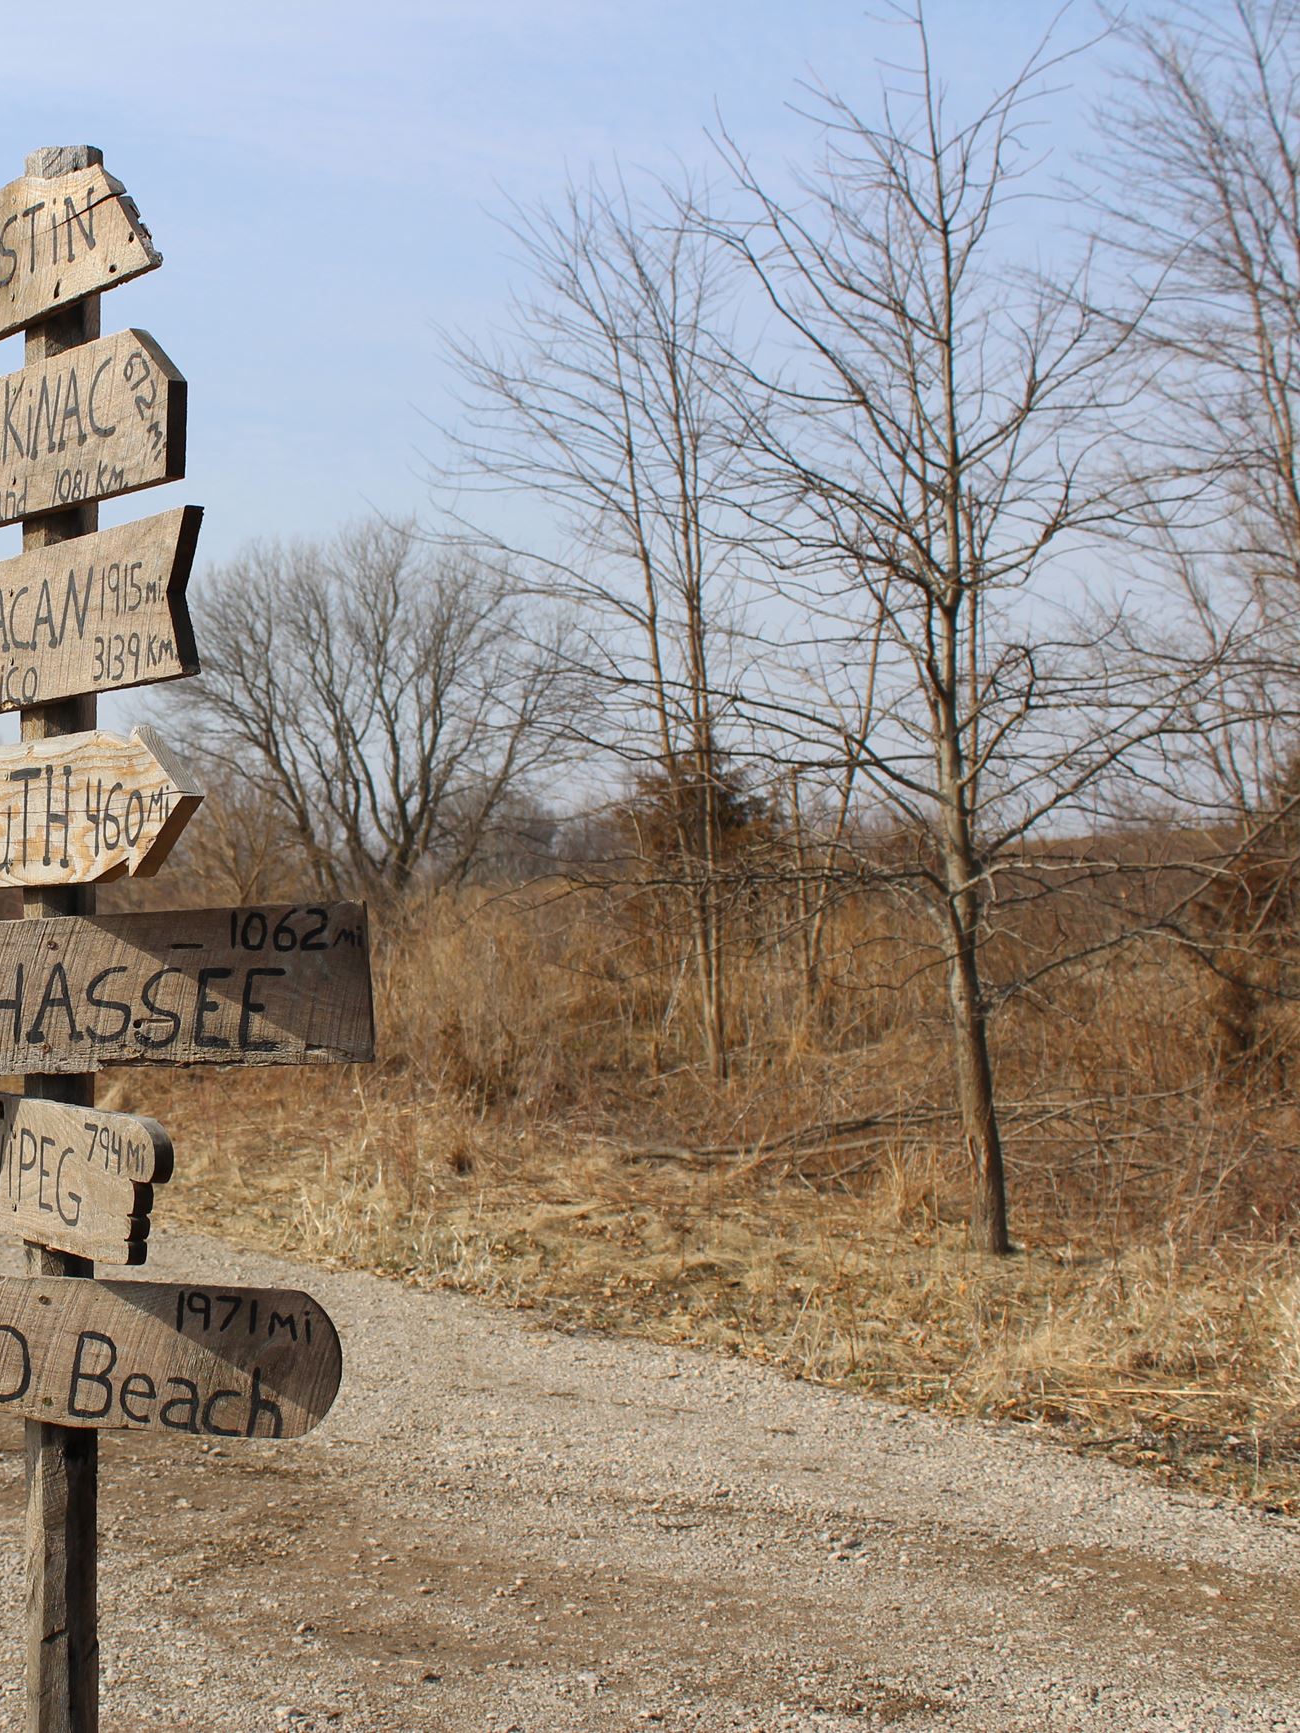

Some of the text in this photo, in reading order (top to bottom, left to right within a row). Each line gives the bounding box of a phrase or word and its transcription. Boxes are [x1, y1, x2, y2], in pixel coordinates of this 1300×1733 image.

[100, 561, 142, 620] 1915
[93, 632, 140, 681] 3139
[85, 782, 144, 857] 460
[230, 908, 328, 952] 1062
[84, 1123, 122, 1175] 794
[175, 1290, 259, 1333] 1971
[67, 1330, 285, 1438] Beach
